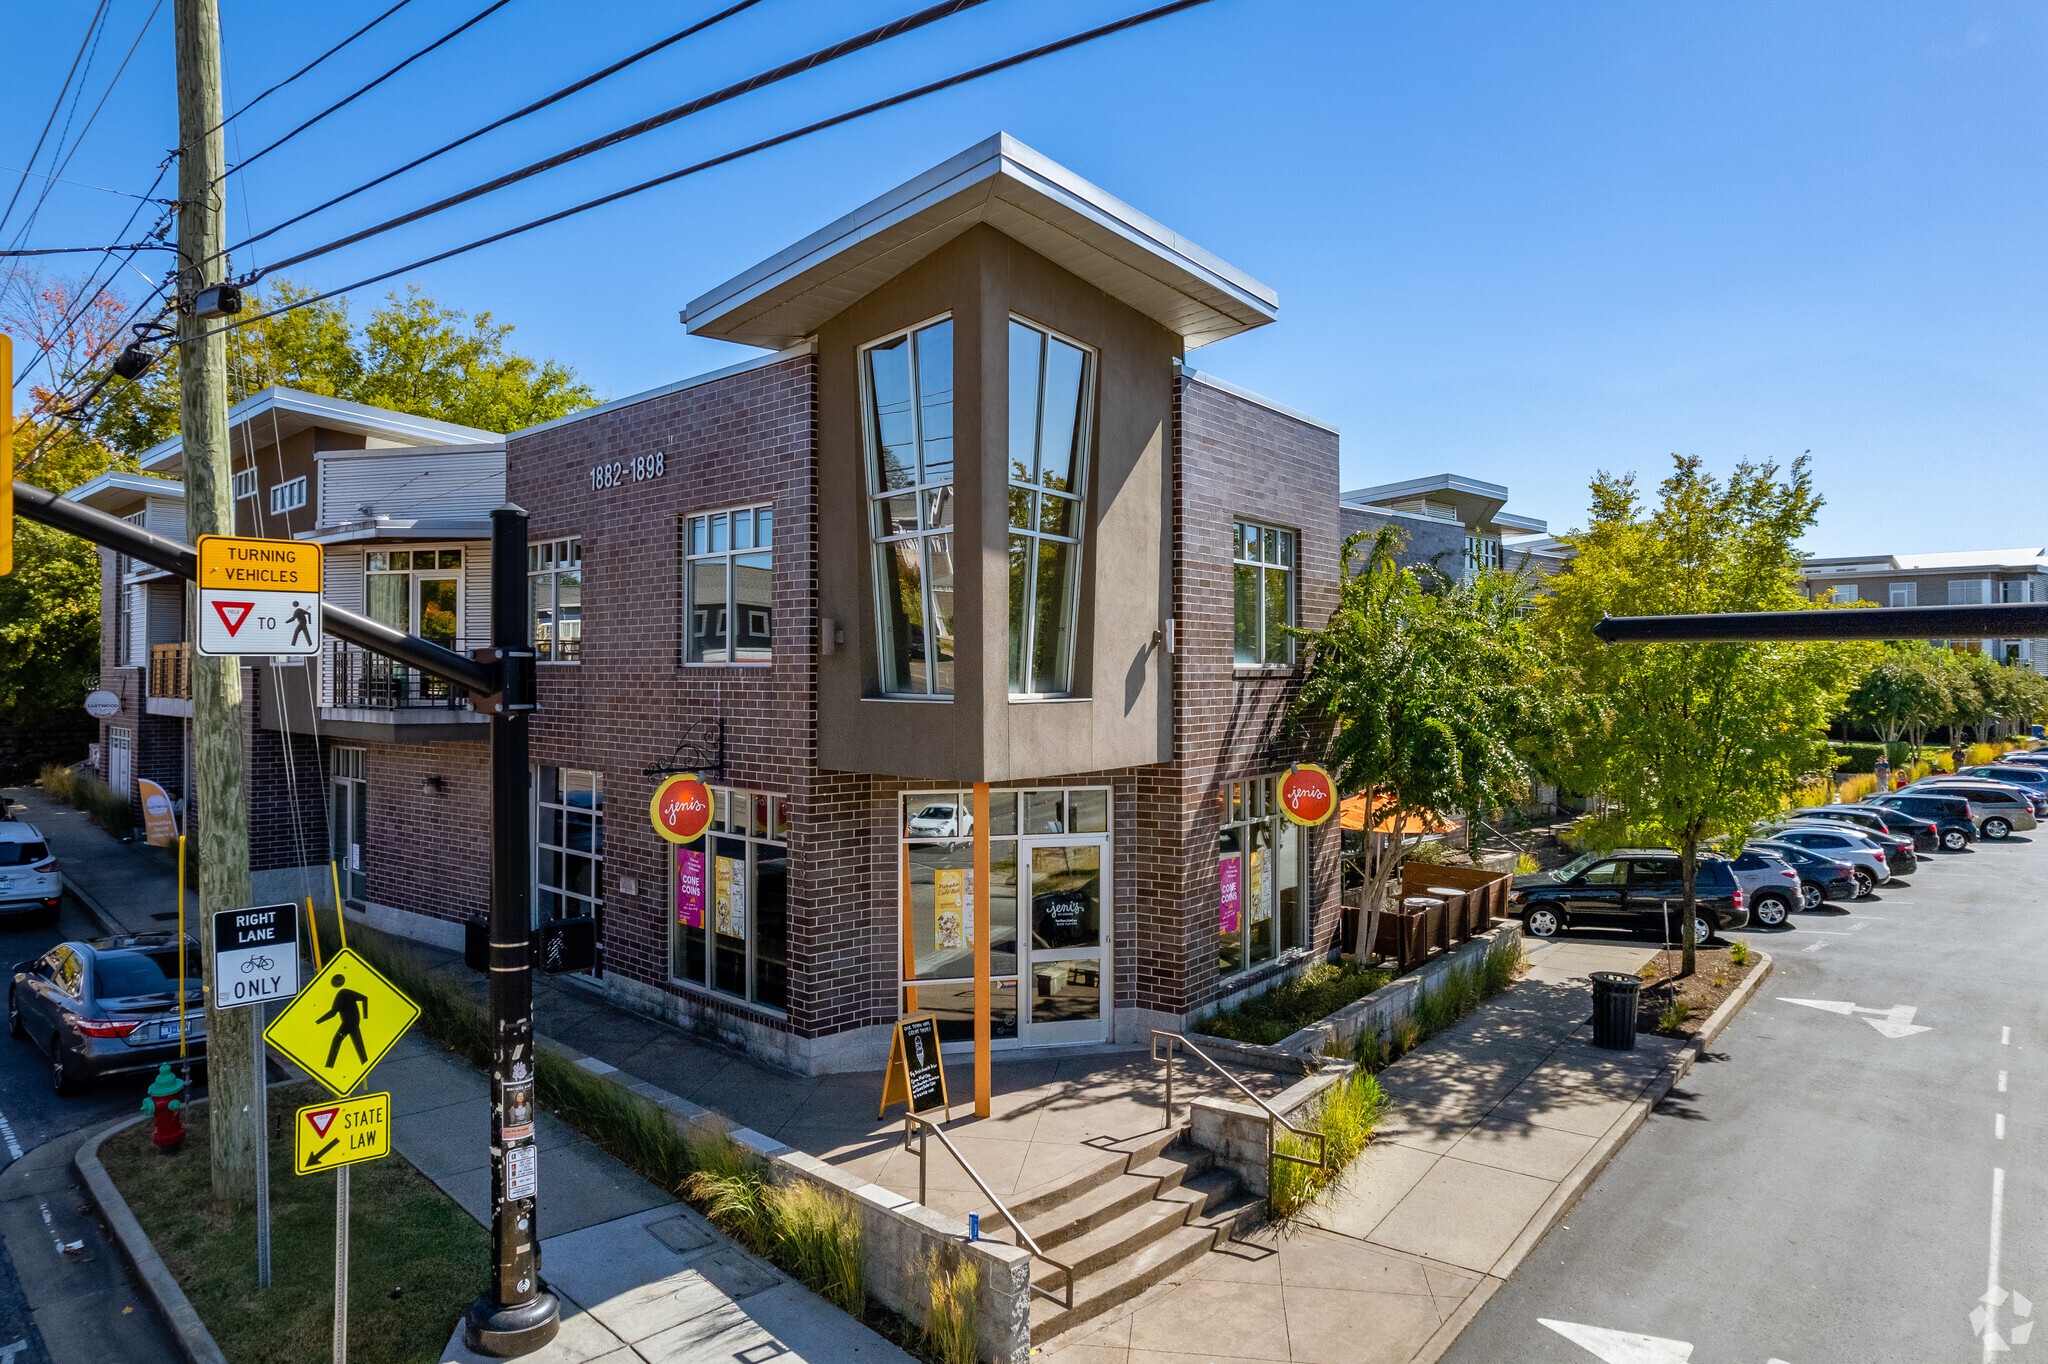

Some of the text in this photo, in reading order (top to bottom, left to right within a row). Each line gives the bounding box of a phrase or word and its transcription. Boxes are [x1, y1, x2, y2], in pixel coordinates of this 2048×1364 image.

[590, 451, 665, 491] 1882-1898
[227, 547, 296, 563] TURNING
[225, 568, 298, 583] VEHICLES
[257, 617, 276, 630] TO
[682, 874, 700, 886] CONE
[1222, 882, 1237, 893] CONE
[681, 884, 701, 897] COINS
[1221, 892, 1238, 904] COINS
[236, 911, 276, 927] RIGHT
[238, 927, 276, 943] LANE
[234, 975, 281, 999] ONLY
[344, 1107, 383, 1129] STATE
[350, 1130, 376, 1150] LAW
